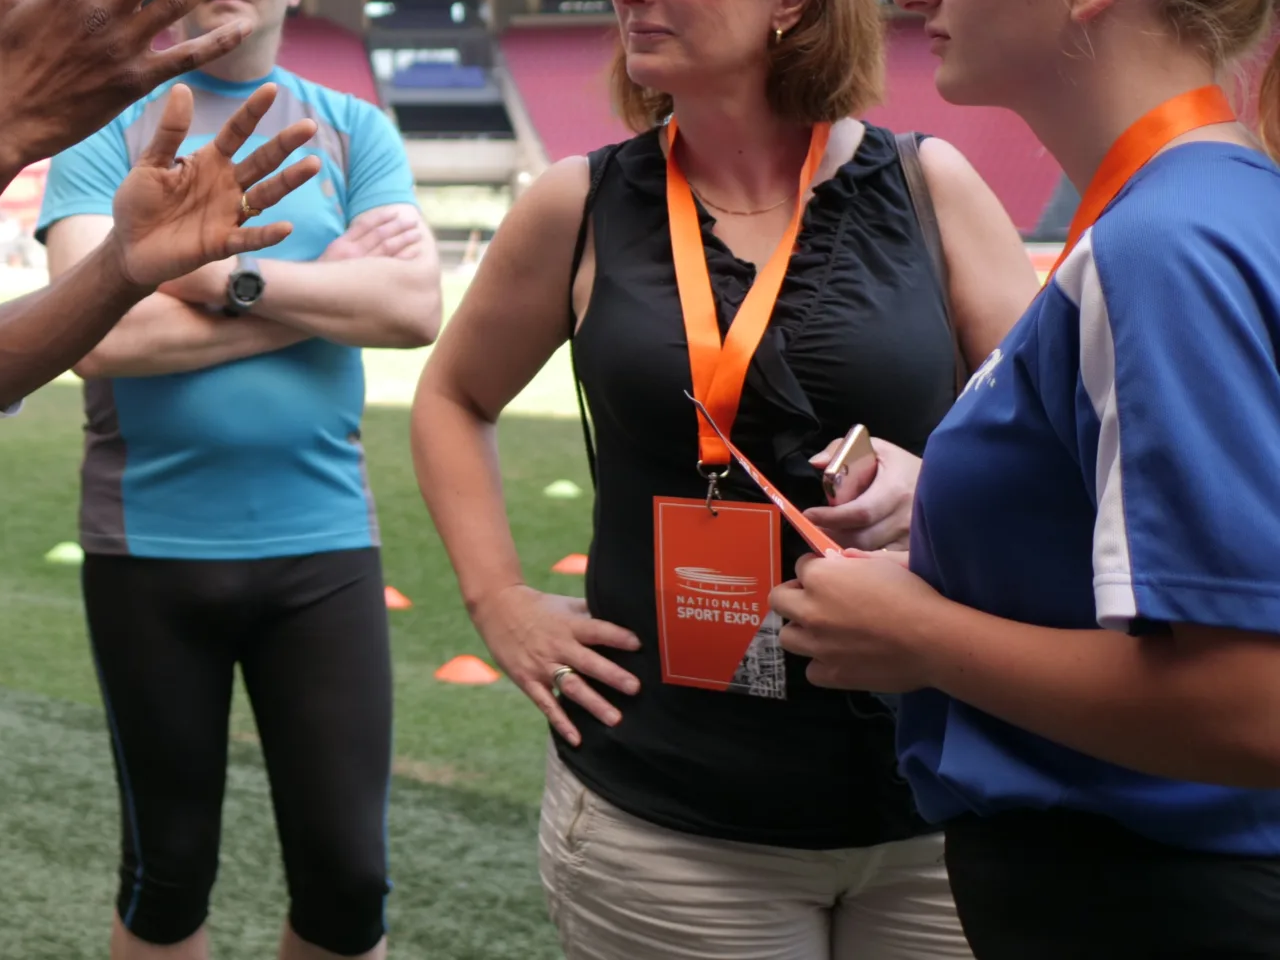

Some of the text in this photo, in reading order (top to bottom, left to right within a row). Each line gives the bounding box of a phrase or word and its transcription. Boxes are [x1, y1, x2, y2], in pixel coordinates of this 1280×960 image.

[676, 595, 760, 612] NATIONALE
[677, 606, 760, 627] SPORT EXPO
